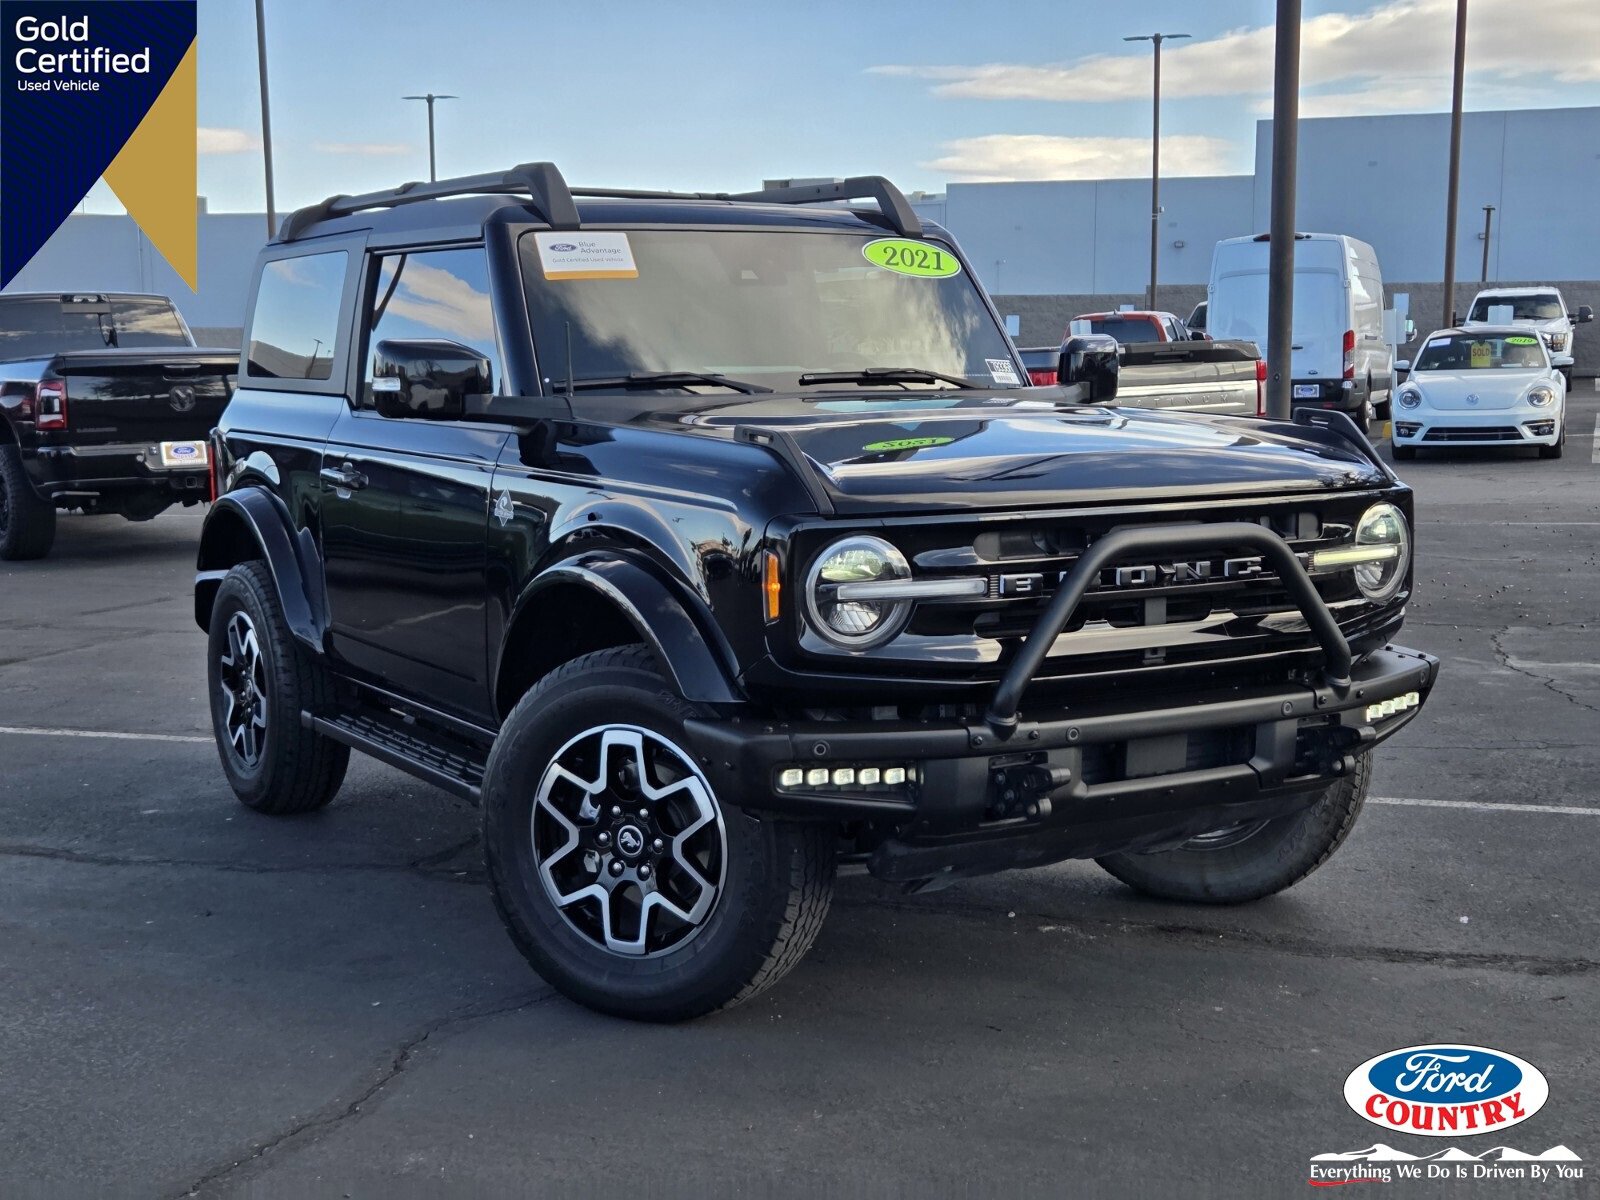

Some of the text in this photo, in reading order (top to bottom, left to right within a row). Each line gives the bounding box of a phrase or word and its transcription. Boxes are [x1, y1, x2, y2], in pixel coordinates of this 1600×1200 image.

[883, 246, 945, 271] 2021
[1472, 347, 1490, 357] SOLD
[1000, 553, 1309, 594] BONC
